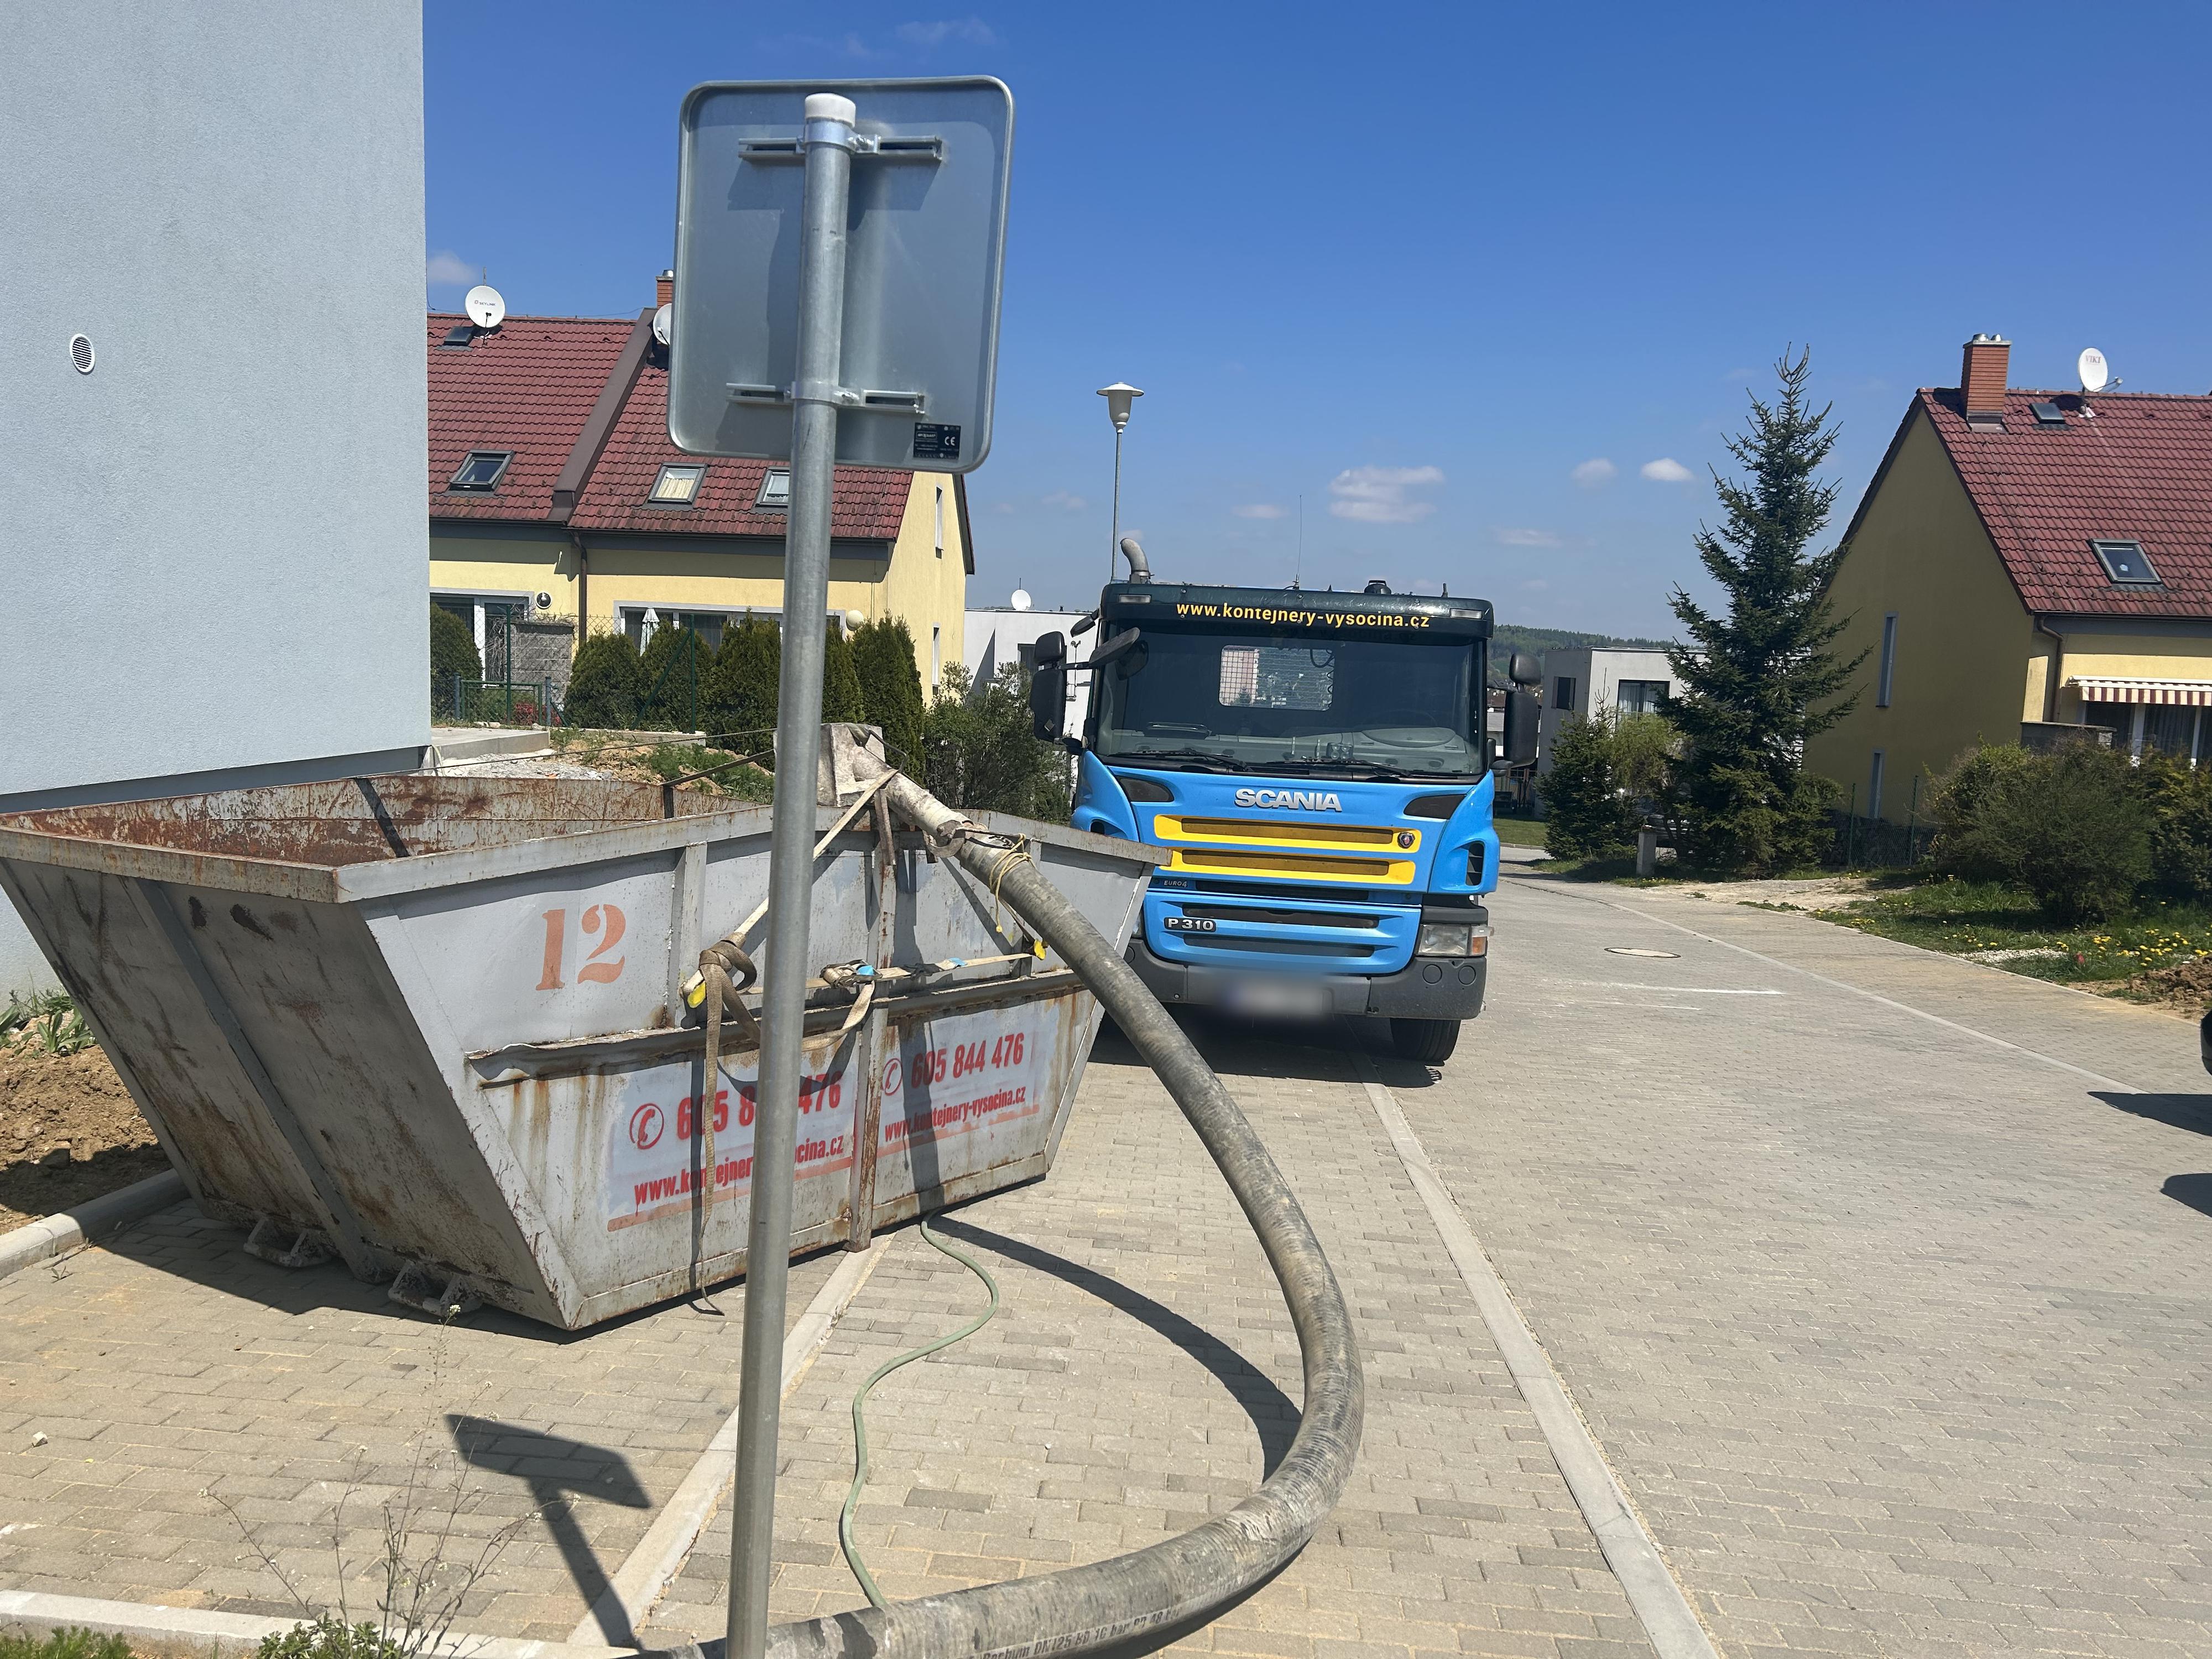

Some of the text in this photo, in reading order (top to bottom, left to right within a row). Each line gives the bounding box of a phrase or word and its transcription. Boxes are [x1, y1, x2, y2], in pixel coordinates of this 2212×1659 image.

[945, 436, 956, 446] CE
[1176, 602, 1430, 628] www.kontejnery-vysocina.cz
[1234, 789, 1343, 812] SCANIA
[1168, 918, 1214, 930] P 310
[535, 903, 627, 991] 12
[911, 1032, 1025, 1089] 605 844 476
[798, 1071, 841, 1114] 476
[884, 1086, 1026, 1142] www.kontejnery-vysocina.cz
[634, 1135, 844, 1205] www.konejnercina.cz
